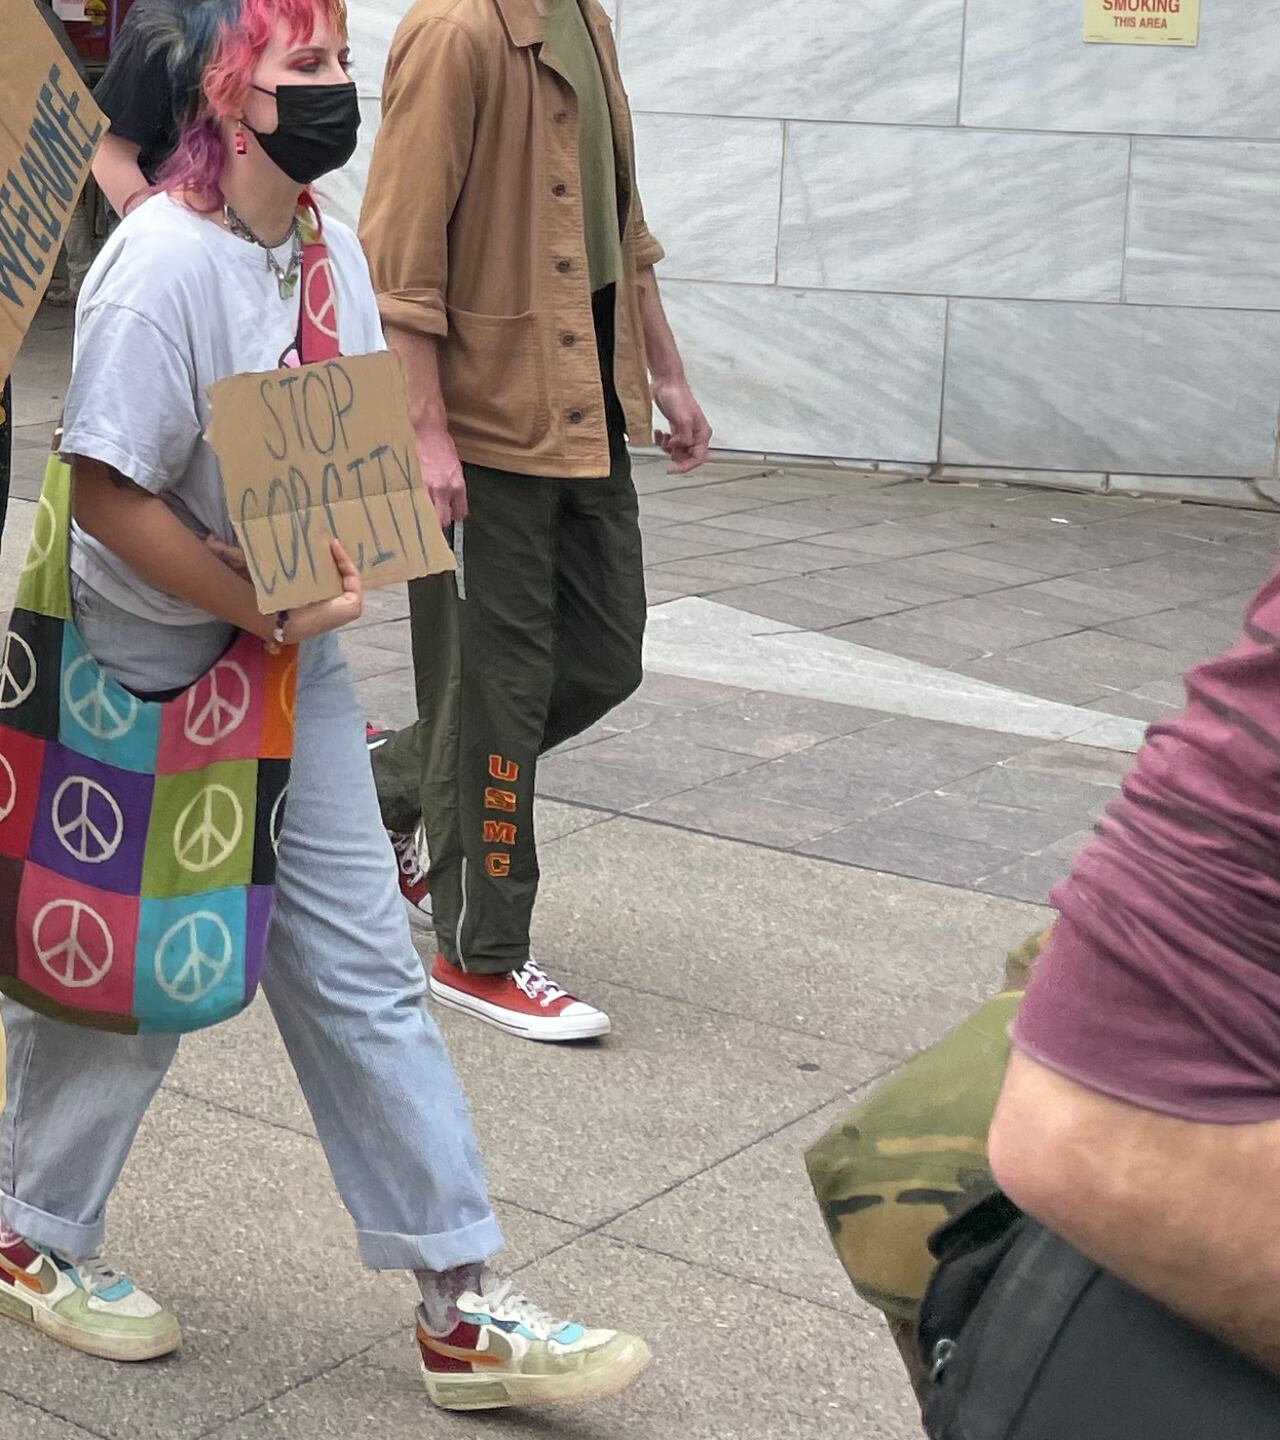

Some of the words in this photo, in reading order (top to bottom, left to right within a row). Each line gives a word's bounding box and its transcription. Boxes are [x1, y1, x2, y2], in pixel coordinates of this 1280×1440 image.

[1113, 16, 1136, 28] THIS
[1139, 17, 1168, 29] AREA
[259, 361, 354, 460] STOP
[240, 464, 319, 595] COP
[321, 445, 430, 572] CITY
